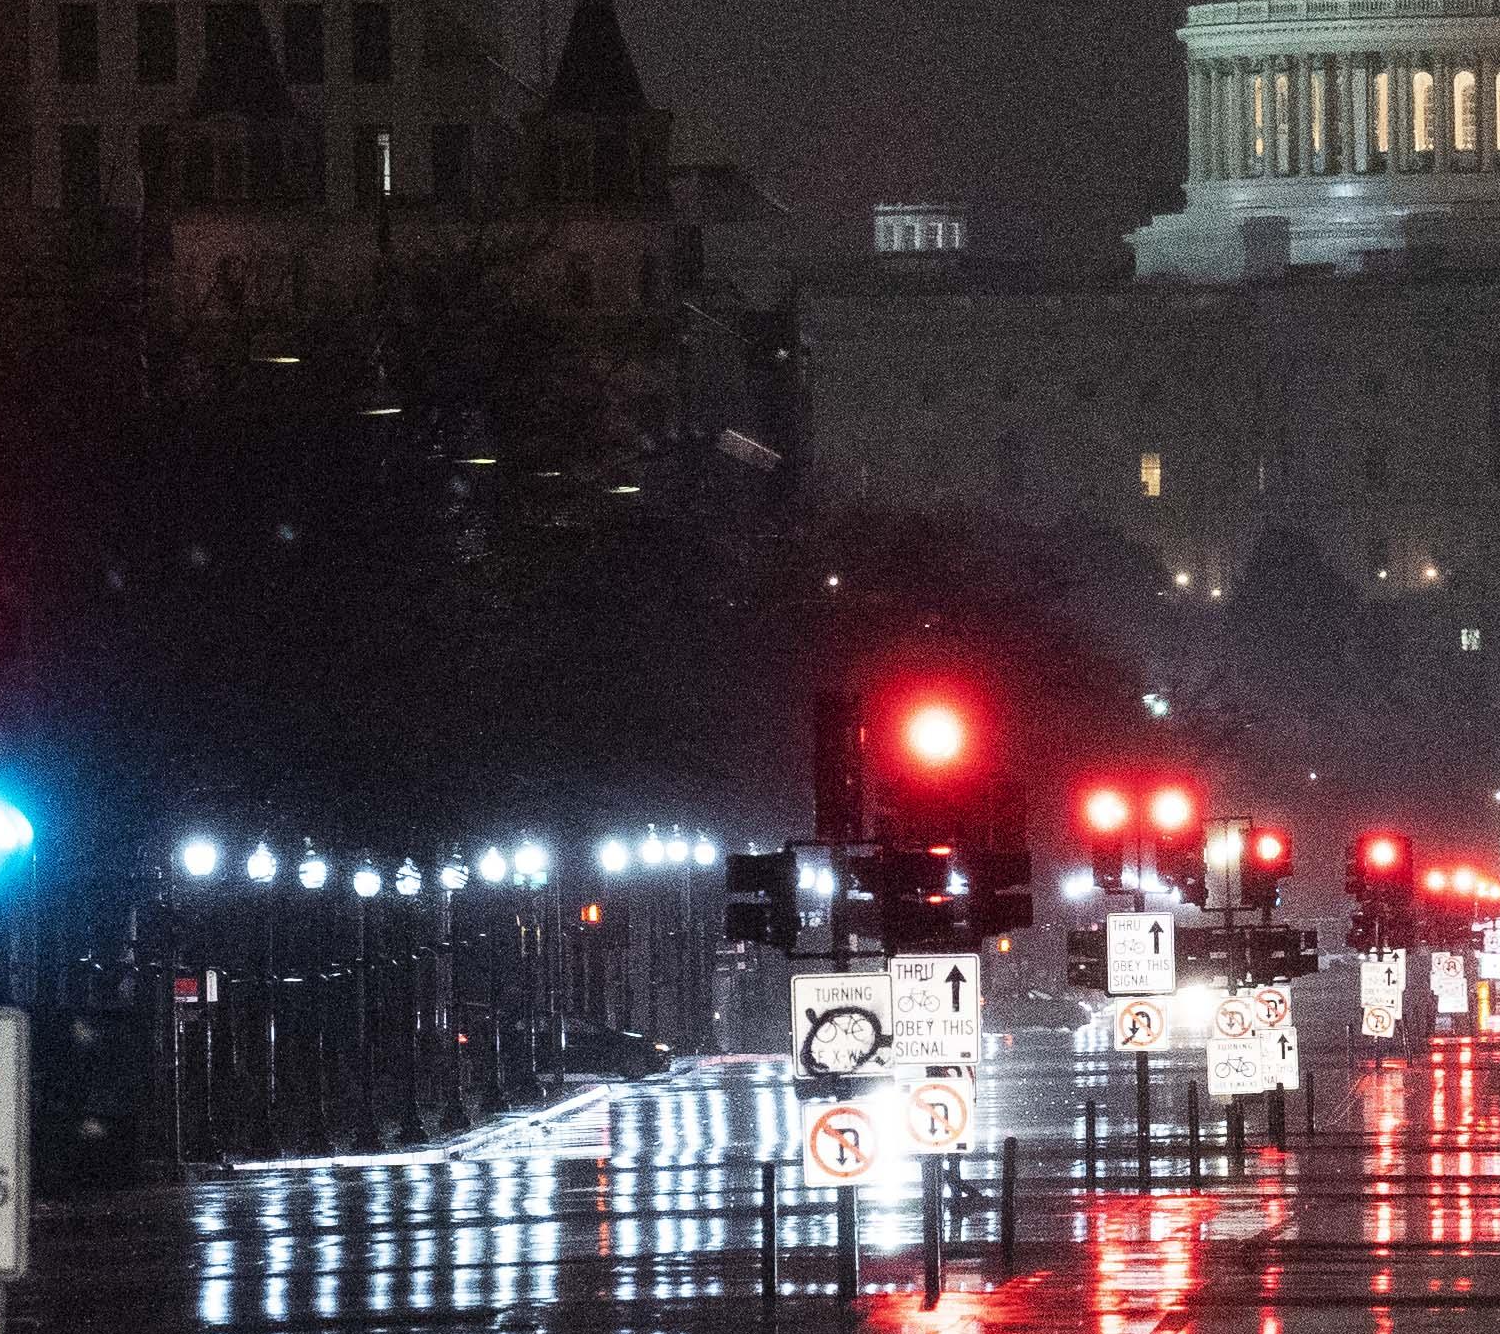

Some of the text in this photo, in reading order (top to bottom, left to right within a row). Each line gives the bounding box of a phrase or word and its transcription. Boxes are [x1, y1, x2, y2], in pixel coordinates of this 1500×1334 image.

[1112, 919, 1141, 932] THRU
[896, 963, 935, 981] THRU
[1113, 959, 1170, 973] OBEY THIS
[1113, 974, 1149, 988] SIGNAL
[815, 986, 873, 1003] TURNING
[895, 1019, 974, 1037] OBEY THIS
[895, 1041, 948, 1058] SIGNAL
